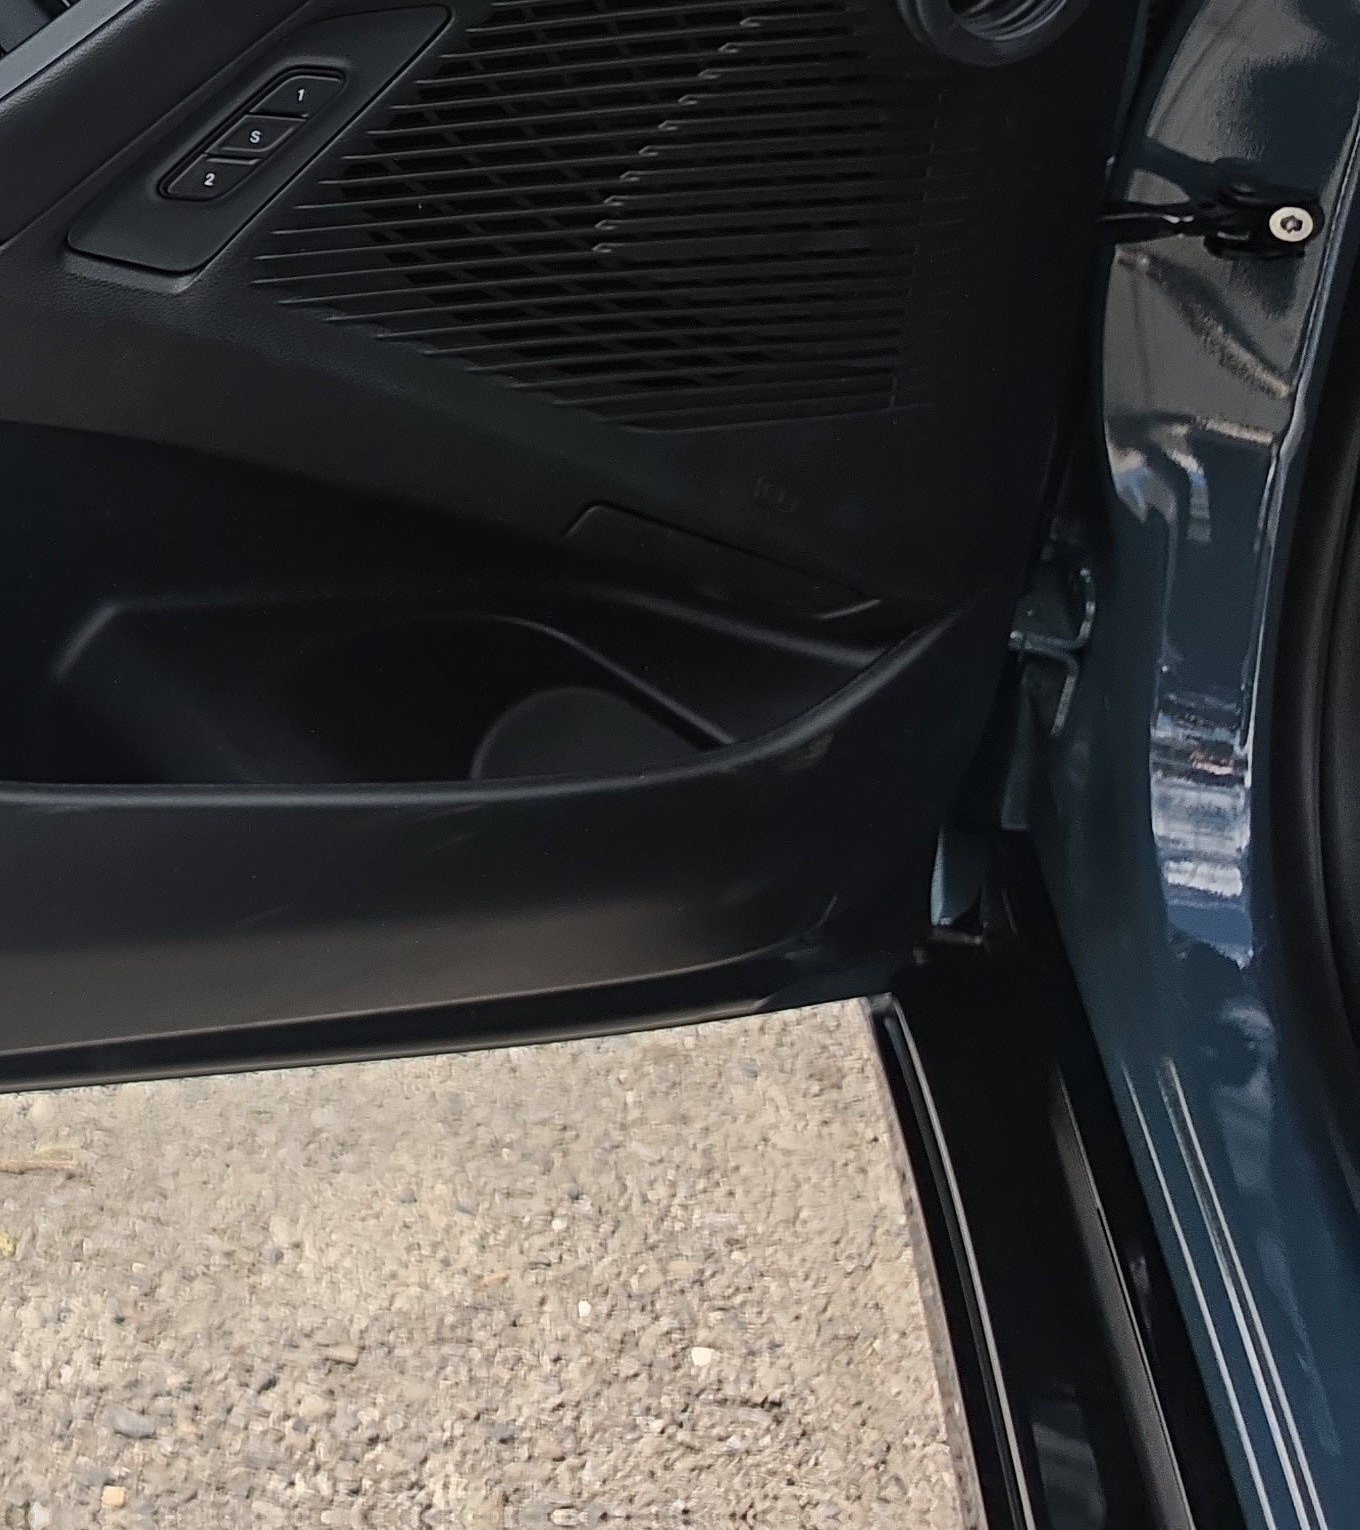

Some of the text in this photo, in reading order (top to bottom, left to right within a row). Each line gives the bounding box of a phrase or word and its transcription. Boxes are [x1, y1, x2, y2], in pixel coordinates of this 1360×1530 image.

[297, 88, 305, 102] 1
[249, 130, 262, 144] S
[203, 172, 216, 186] 2
